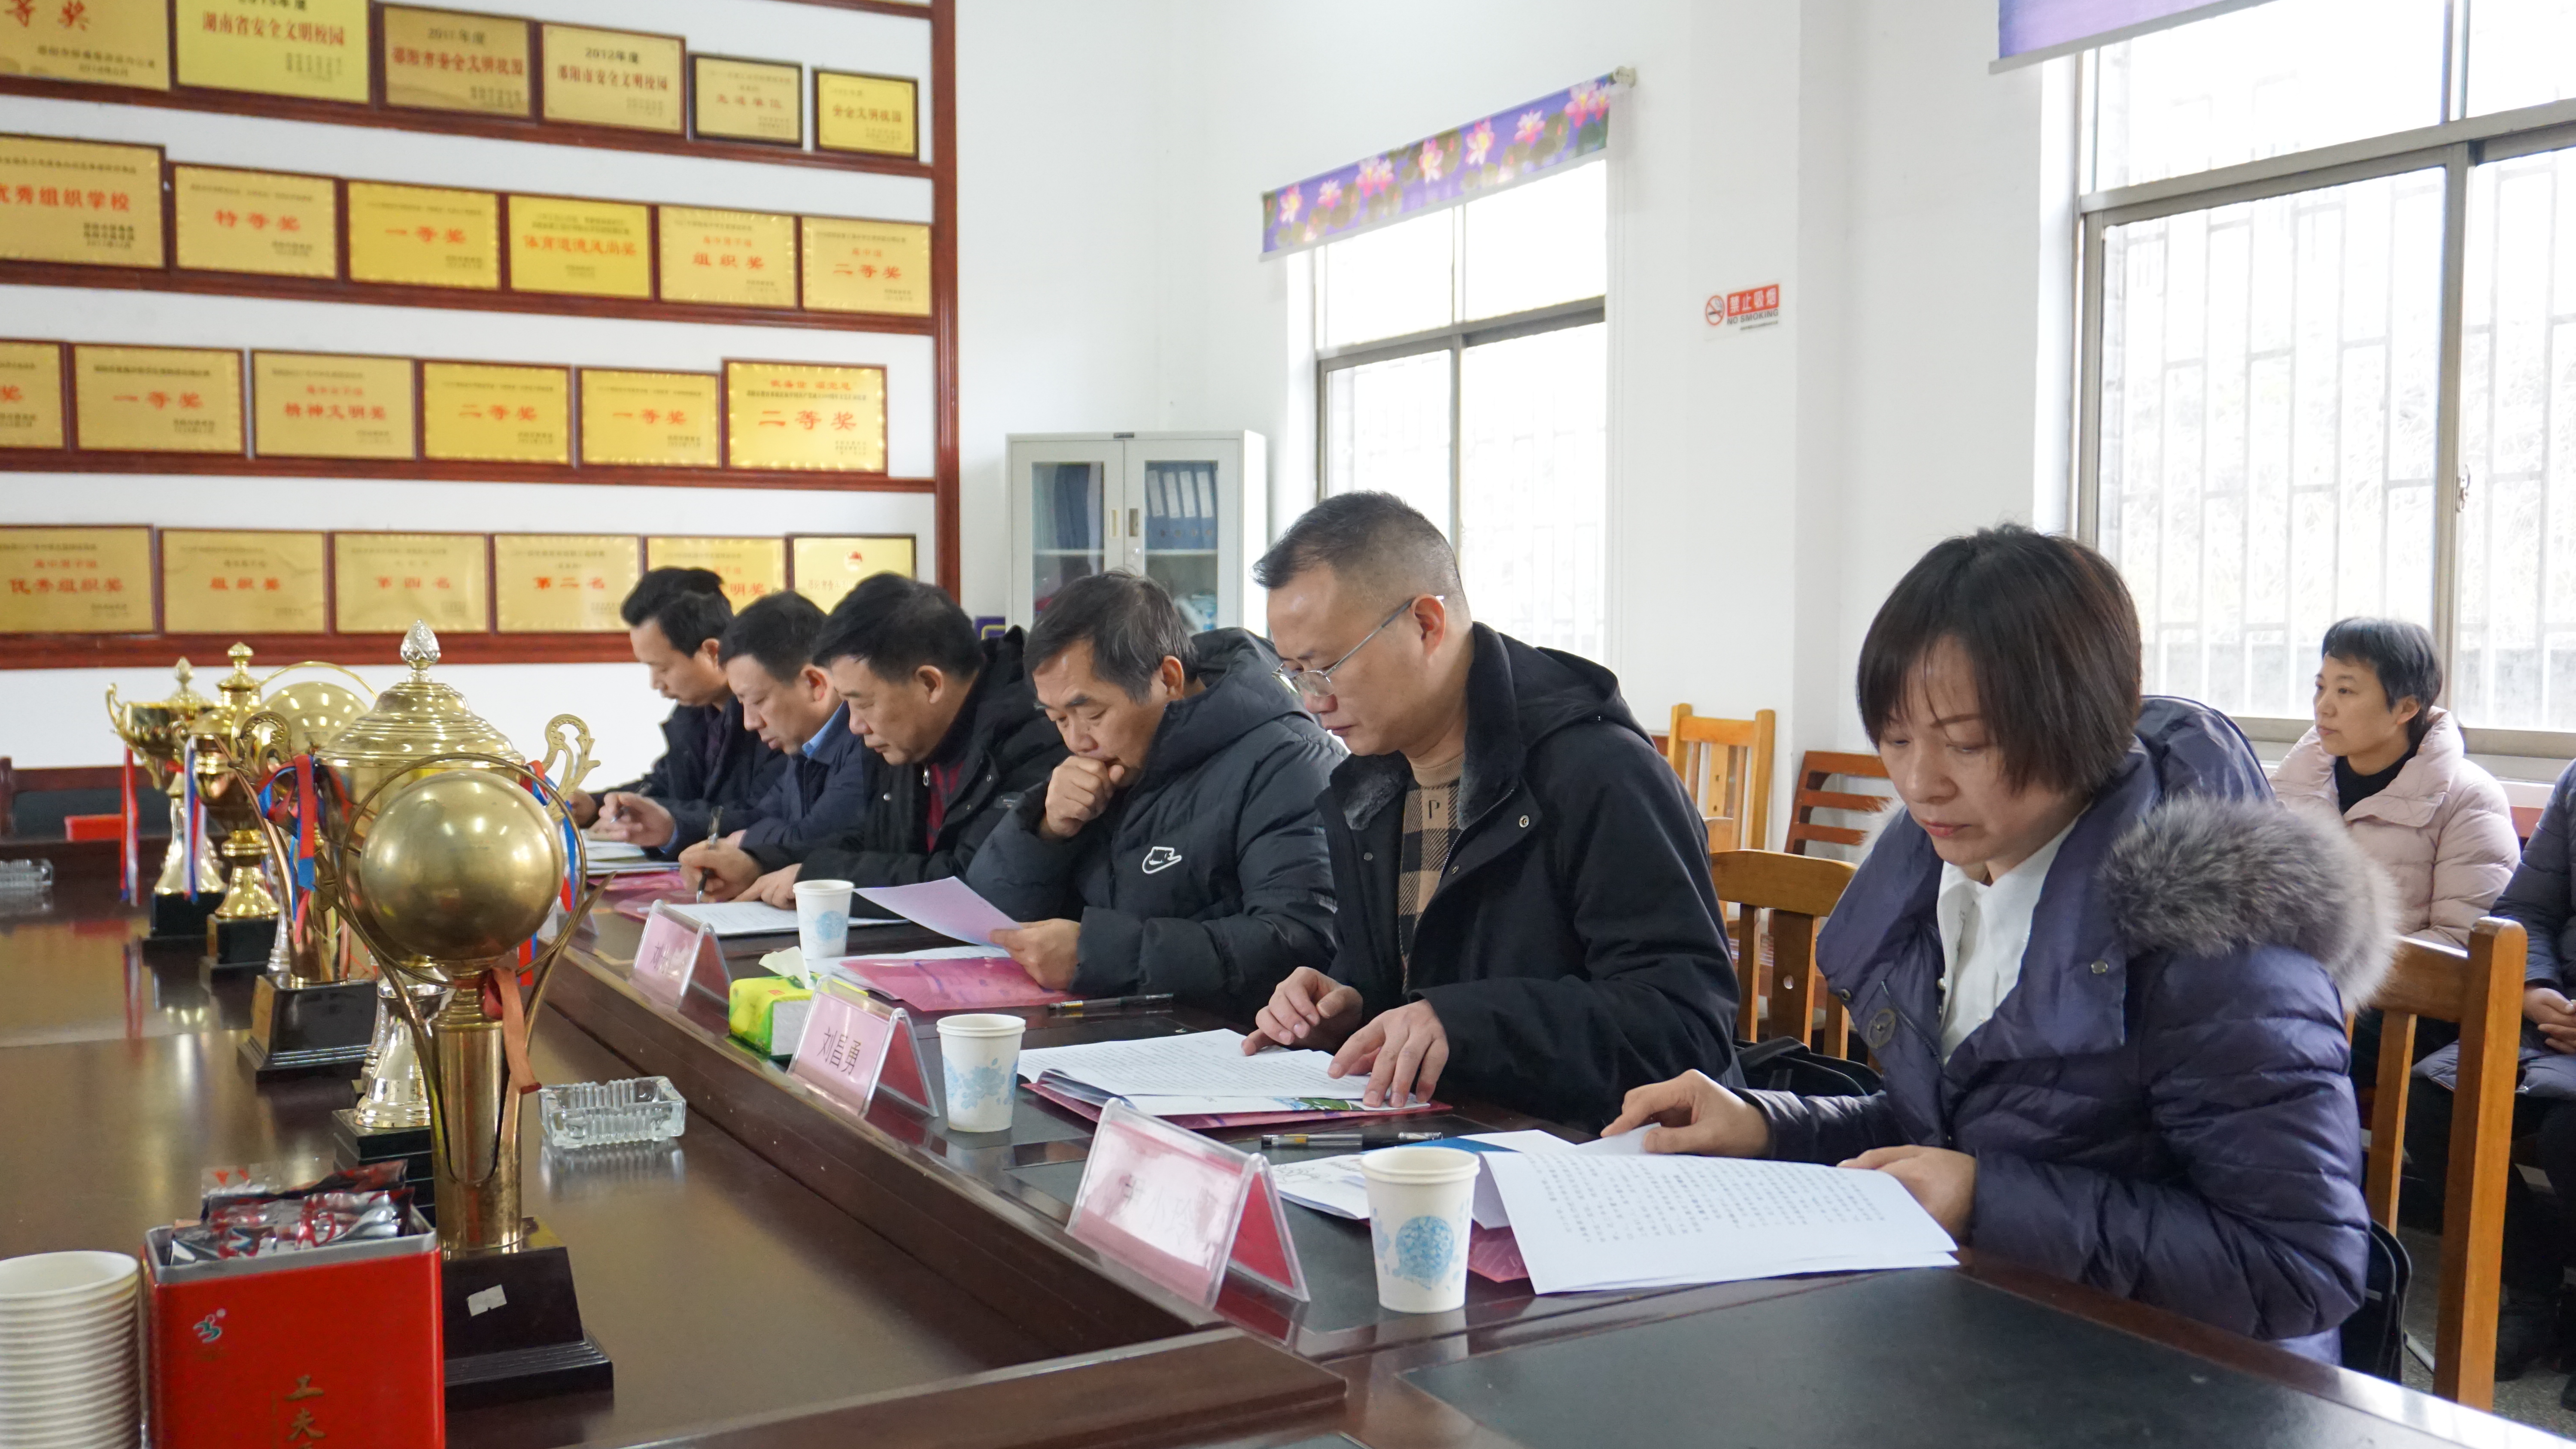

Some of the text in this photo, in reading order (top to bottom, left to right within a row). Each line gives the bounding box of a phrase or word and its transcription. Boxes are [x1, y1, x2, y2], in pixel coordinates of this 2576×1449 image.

[202, 11, 345, 45] 湖南省安全文明校园
[392, 46, 523, 75] 邵阳市安全文明校园
[585, 48, 639, 64] 2012年度
[559, 65, 668, 90] 邵阳市安全文明校园
[832, 103, 902, 123] 安全文明校园
[215, 209, 299, 231] 特等奖
[386, 226, 465, 243] 一等奖
[693, 252, 765, 269] 组织奖
[833, 264, 901, 278] 二等奖
[1730, 288, 1776, 313] 禁止吸烟
[1741, 309, 1778, 322] SMOKING
[113, 391, 203, 410] 一等奖
[284, 402, 386, 420] 精神文明奖
[459, 404, 537, 421] 二等奖
[612, 409, 687, 425] 一等奖
[759, 410, 857, 430] 二等奖
[211, 577, 280, 590] 组织奖
[534, 576, 605, 590] 第二名
[284, 1374, 326, 1449] 工夫
